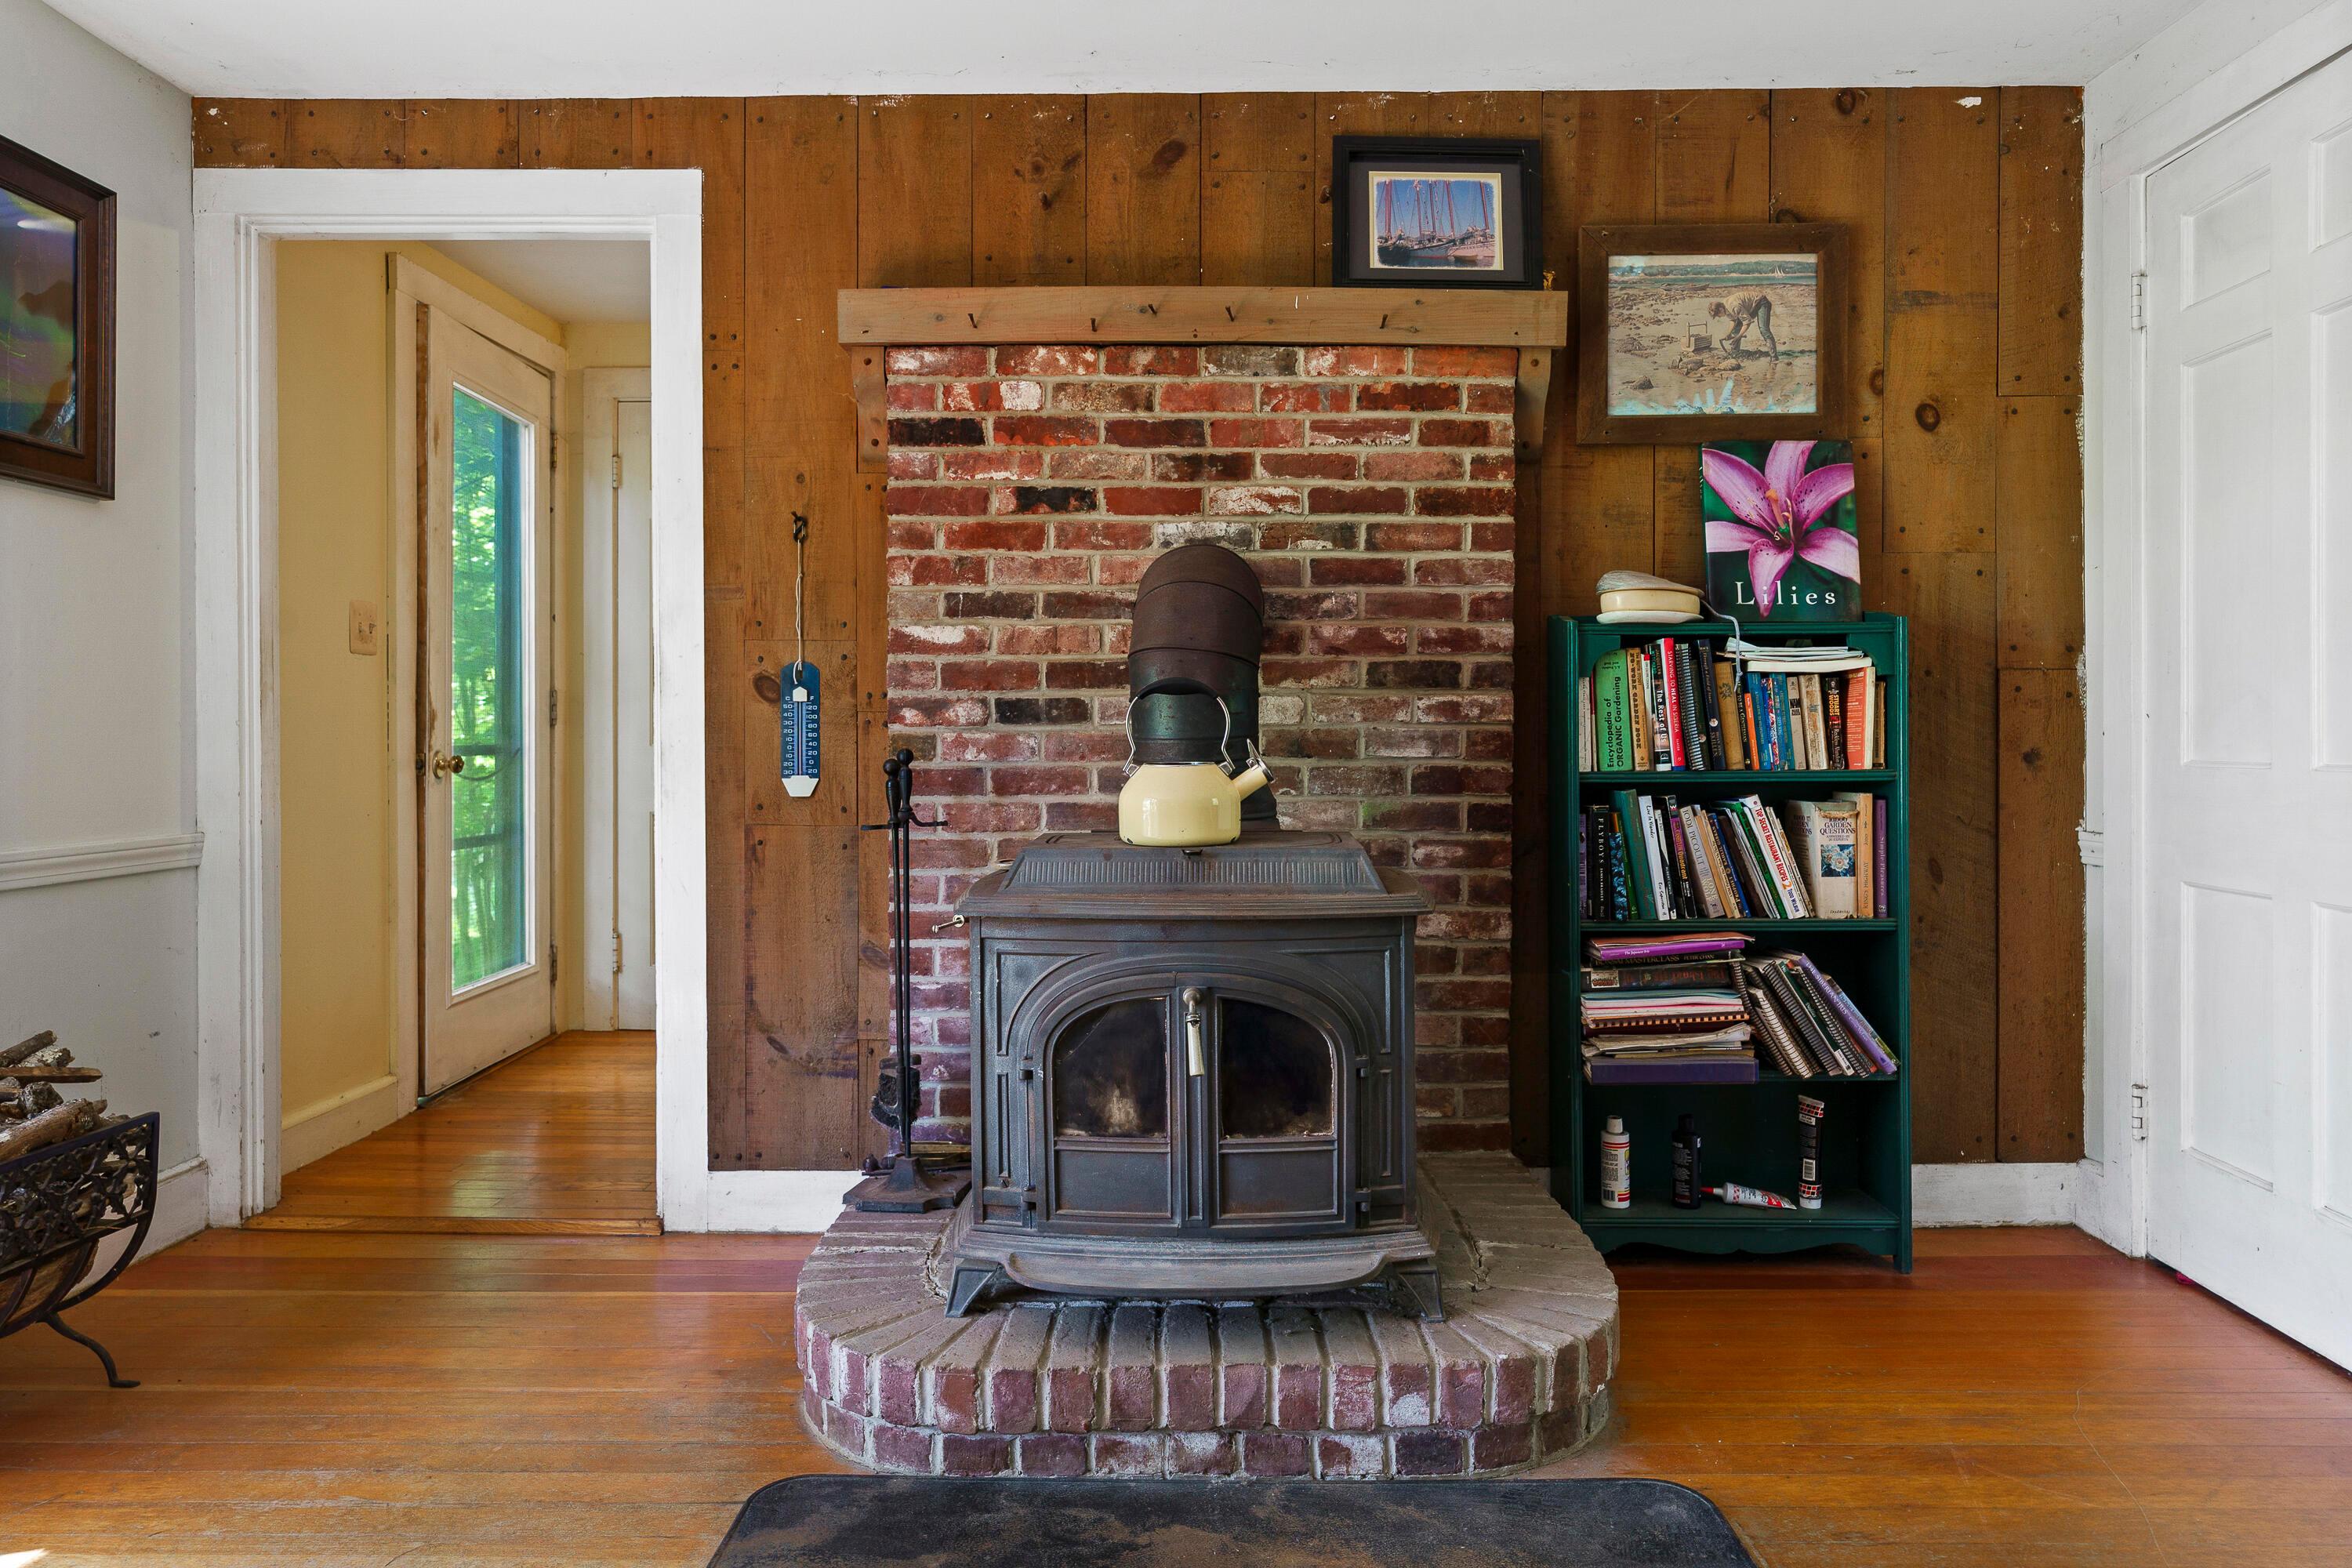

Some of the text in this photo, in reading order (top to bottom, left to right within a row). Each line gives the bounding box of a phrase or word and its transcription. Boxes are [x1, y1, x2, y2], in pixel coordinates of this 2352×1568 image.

[1734, 580, 1836, 605] Lilies
[1603, 698, 1614, 767] Encyclopedia of
[1660, 733, 1667, 742] Us
[1710, 731, 1719, 757] SKILLEN
[1615, 724, 1624, 767] ORGANIC
[1755, 807, 1764, 818] TOP
[1711, 826, 1721, 844] GIBRAN
[1758, 817, 1769, 834] SECRET
[1682, 809, 1693, 829] JODI
[1688, 830, 1704, 866] PICOULT
[1764, 833, 1781, 863] RESTAURANT
[1677, 851, 1687, 880] Quadrant
[1719, 846, 1728, 865] KAHLIL
[1776, 862, 1788, 882] RECIPES
[1702, 878, 1712, 902] WOLF
[1706, 877, 1718, 900] LONE
[1728, 876, 1740, 902] PROPHET
[1781, 880, 1792, 890] 2
[1790, 898, 1799, 913] WILBUR
[1624, 954, 1679, 964] MASTERCLASS
[1804, 961, 1848, 1014] THE SIBERIAN IRIS
